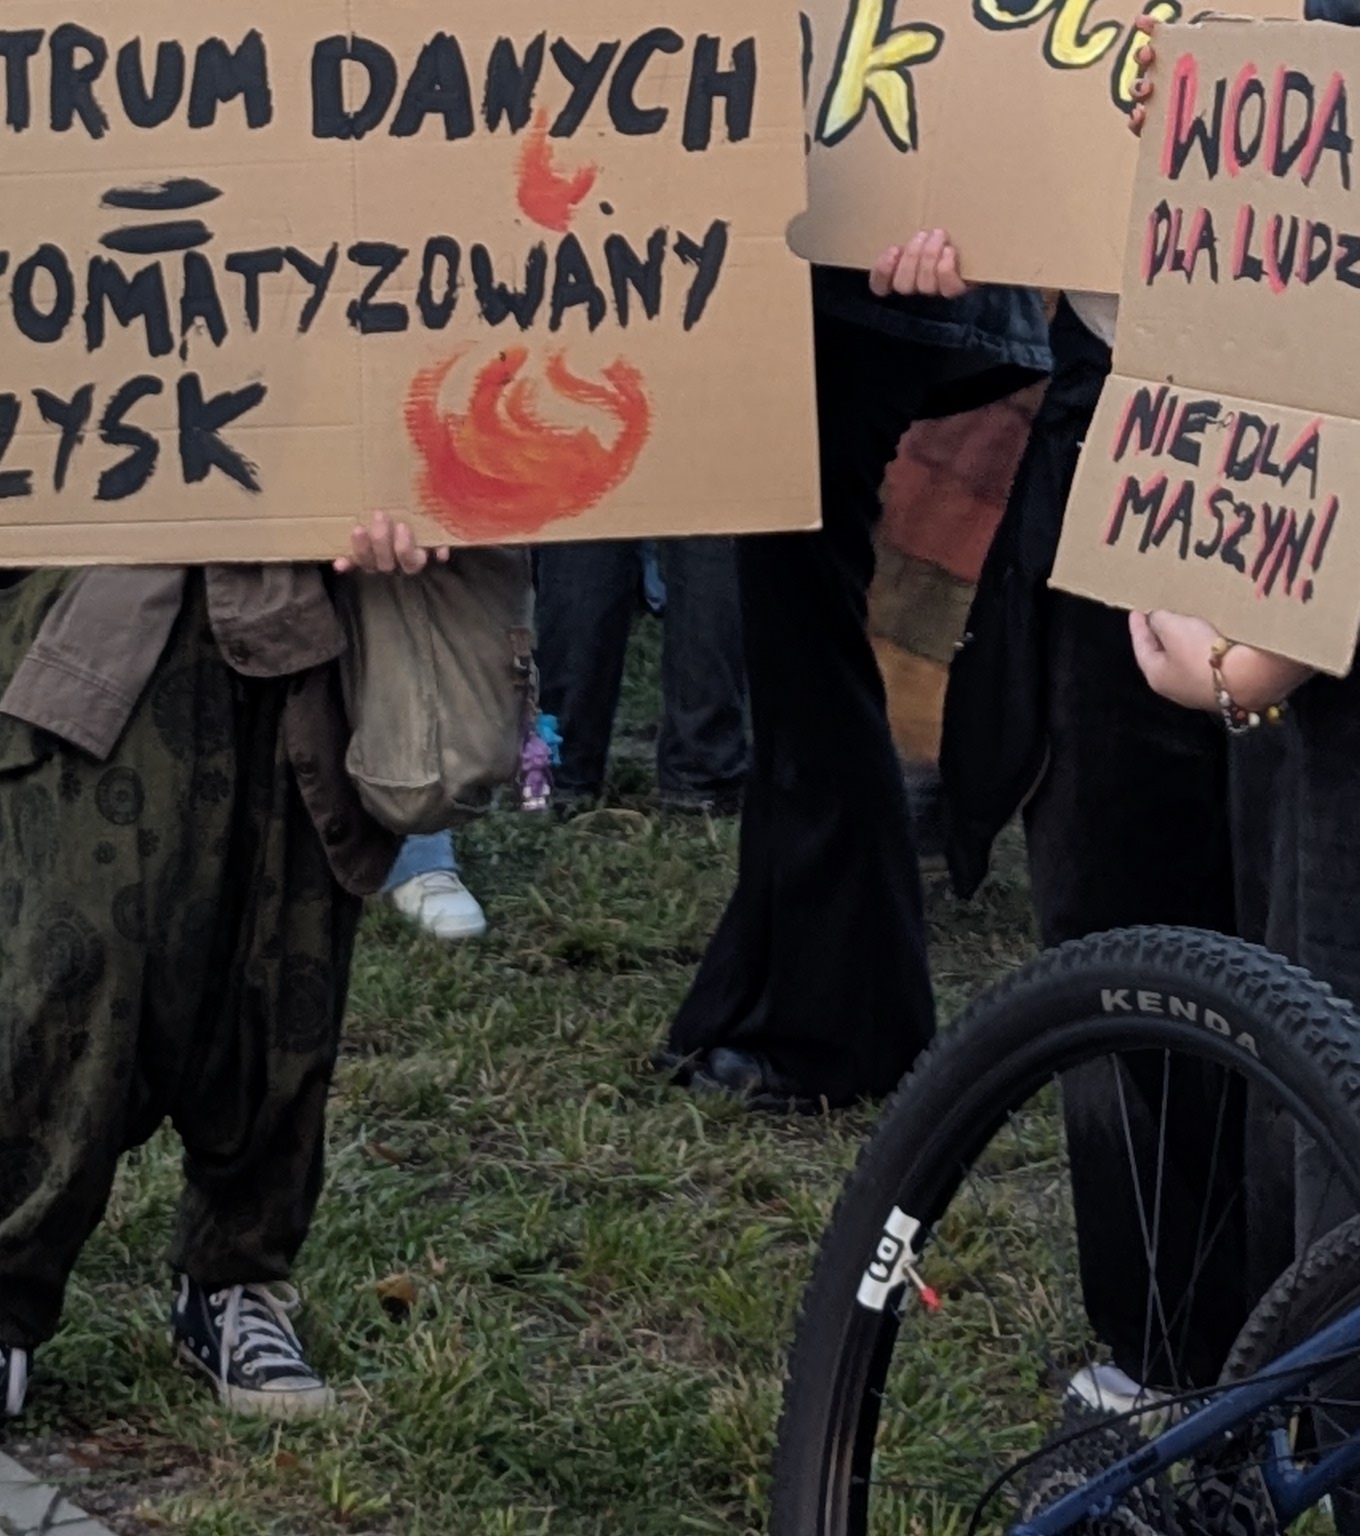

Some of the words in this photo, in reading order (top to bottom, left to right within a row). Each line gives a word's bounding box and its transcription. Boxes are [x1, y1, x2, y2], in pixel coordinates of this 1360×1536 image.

[311, 27, 759, 152] DANYCH
[1161, 52, 1354, 190] WODA
[1141, 199, 1219, 286] DLA
[1109, 384, 1222, 467] NIE
[1216, 416, 1326, 500] DLA
[1100, 469, 1340, 605] MASZYN!
[1100, 988, 1261, 1060] KENDA
